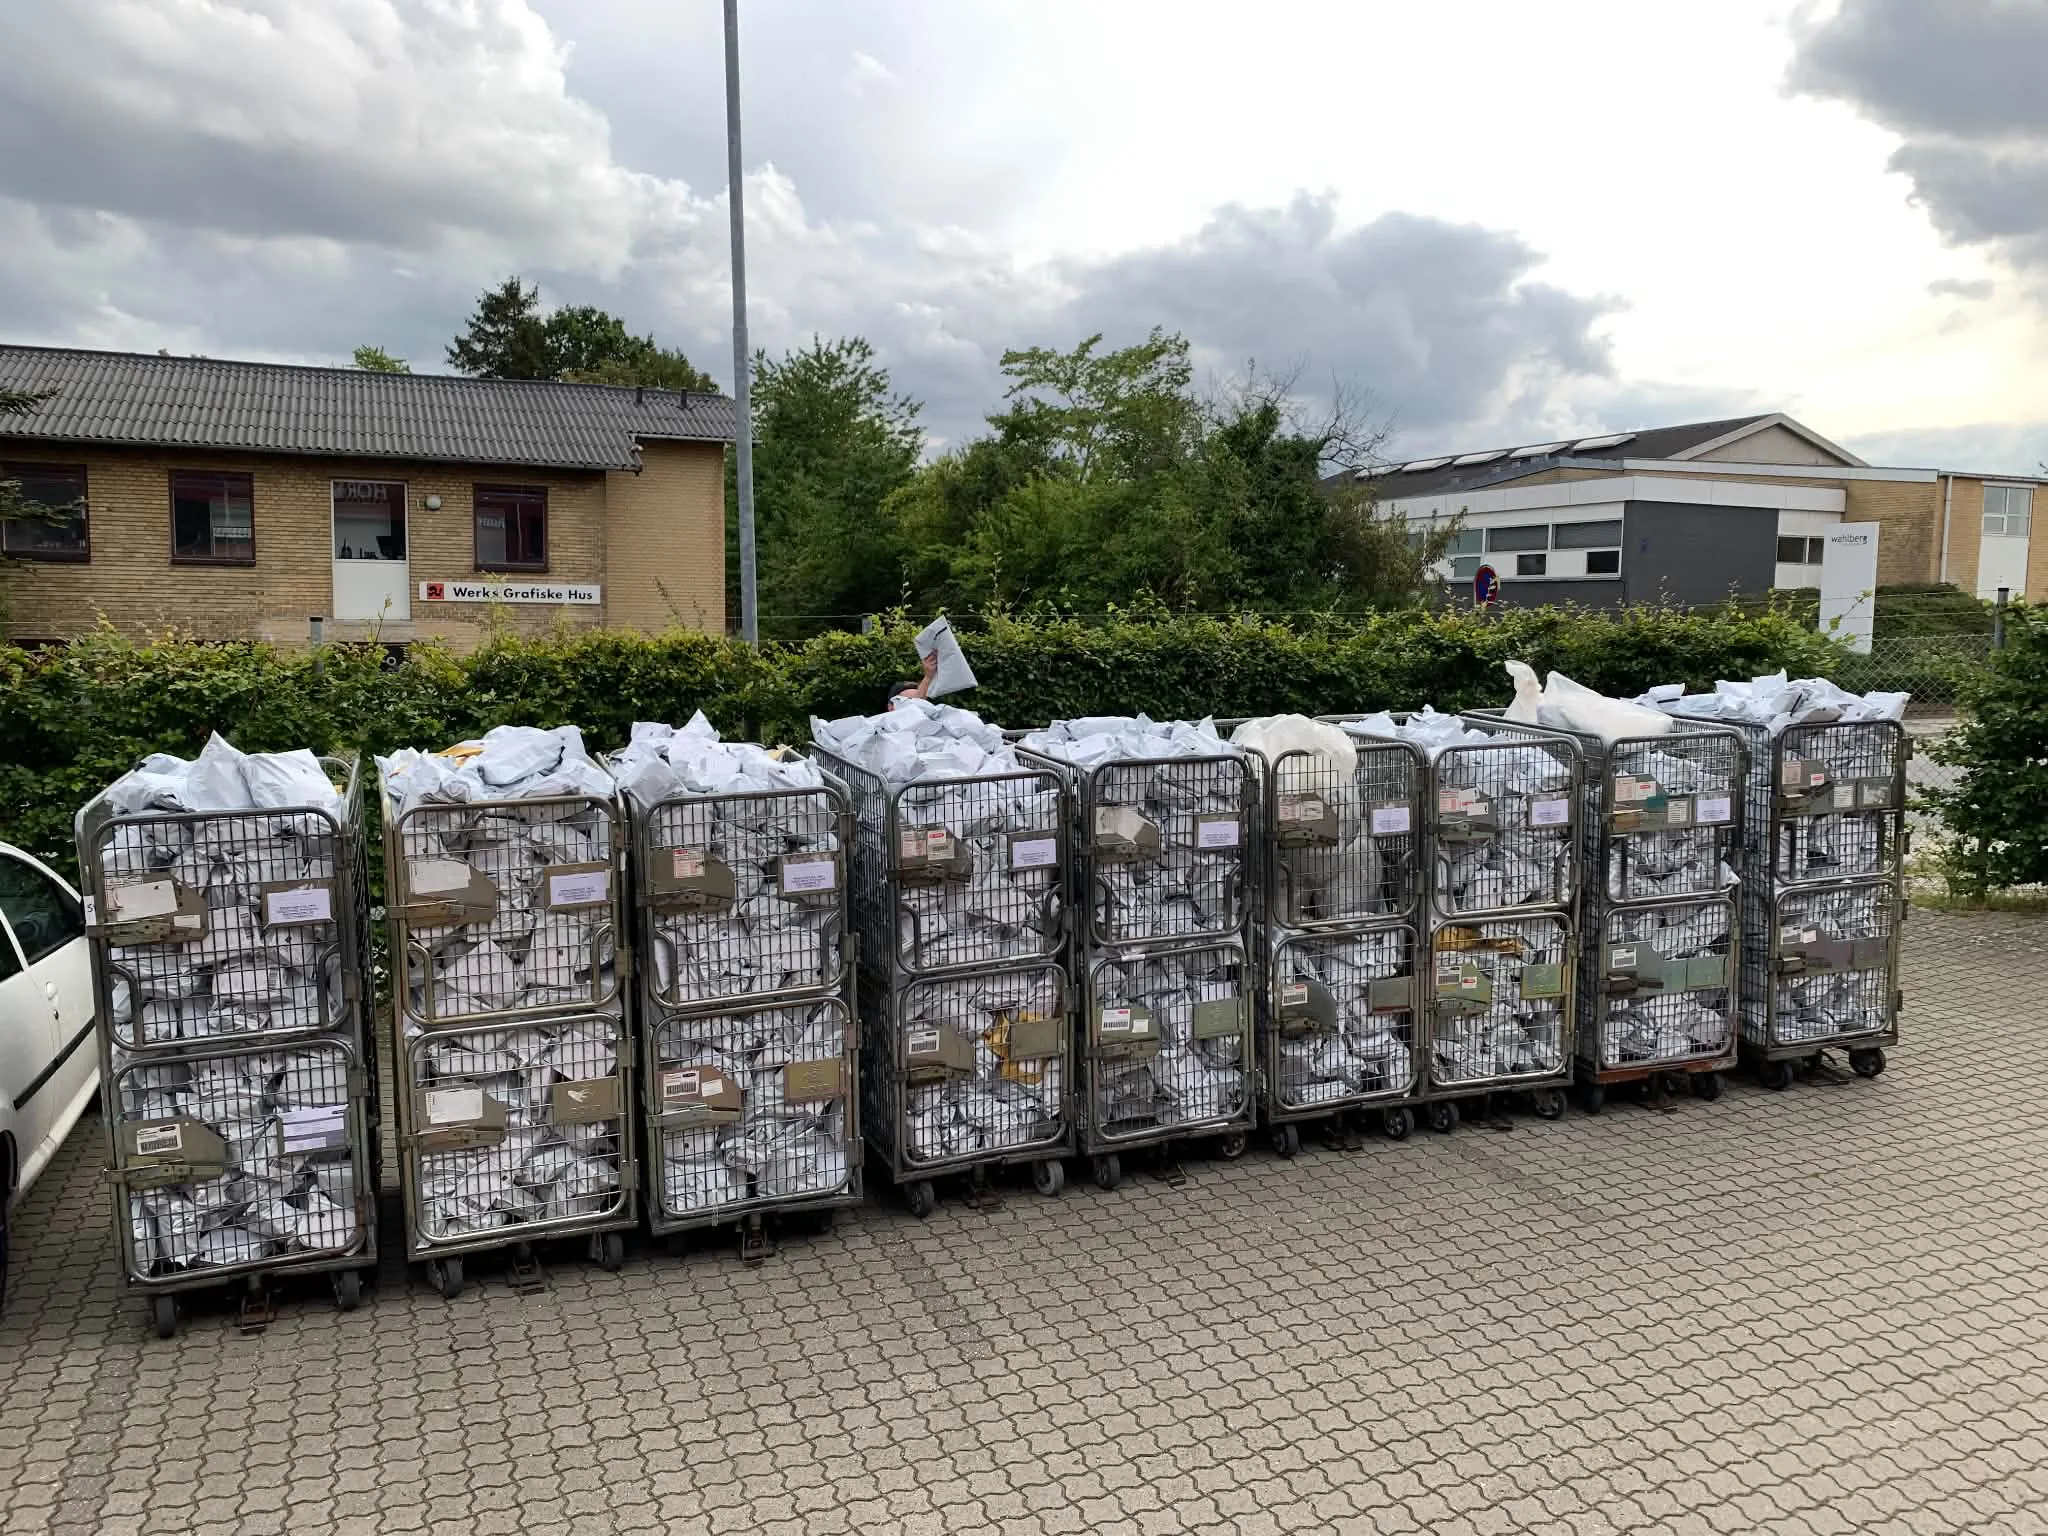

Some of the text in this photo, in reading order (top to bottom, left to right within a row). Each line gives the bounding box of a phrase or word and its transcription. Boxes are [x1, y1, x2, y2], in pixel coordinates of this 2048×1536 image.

[453, 586, 593, 600] Werks Grafiske Hus
